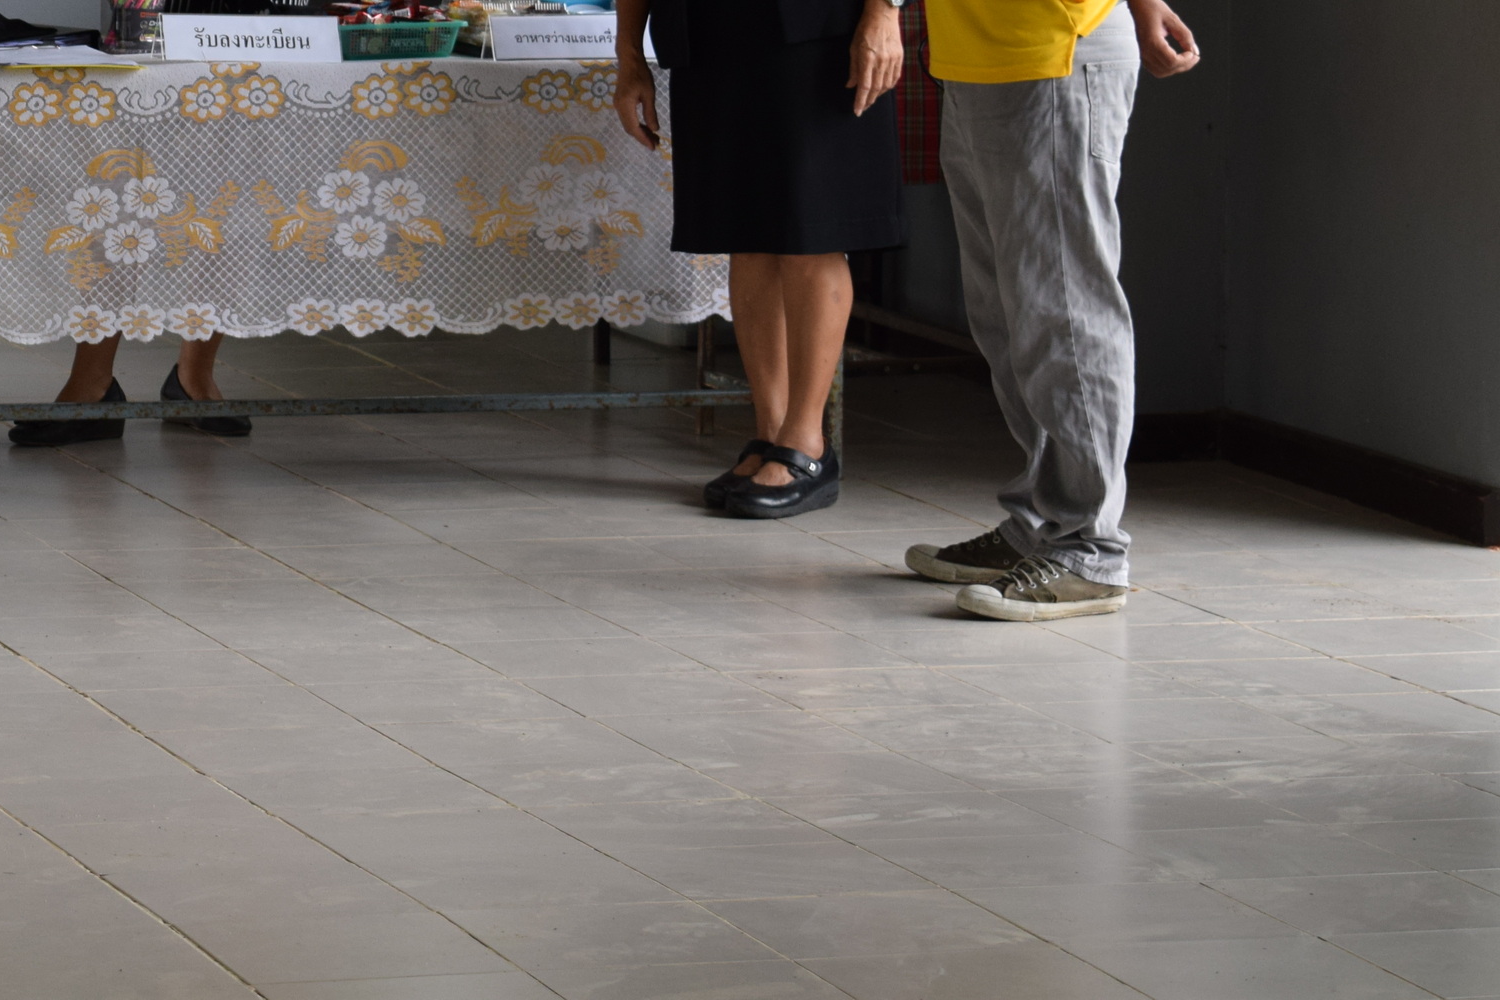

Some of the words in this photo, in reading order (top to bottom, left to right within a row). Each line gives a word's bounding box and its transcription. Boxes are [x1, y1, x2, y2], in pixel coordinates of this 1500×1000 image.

[194, 27, 311, 50] รับลงทะเบียน
[515, 28, 616, 43] อาหารว่างและเครื่
